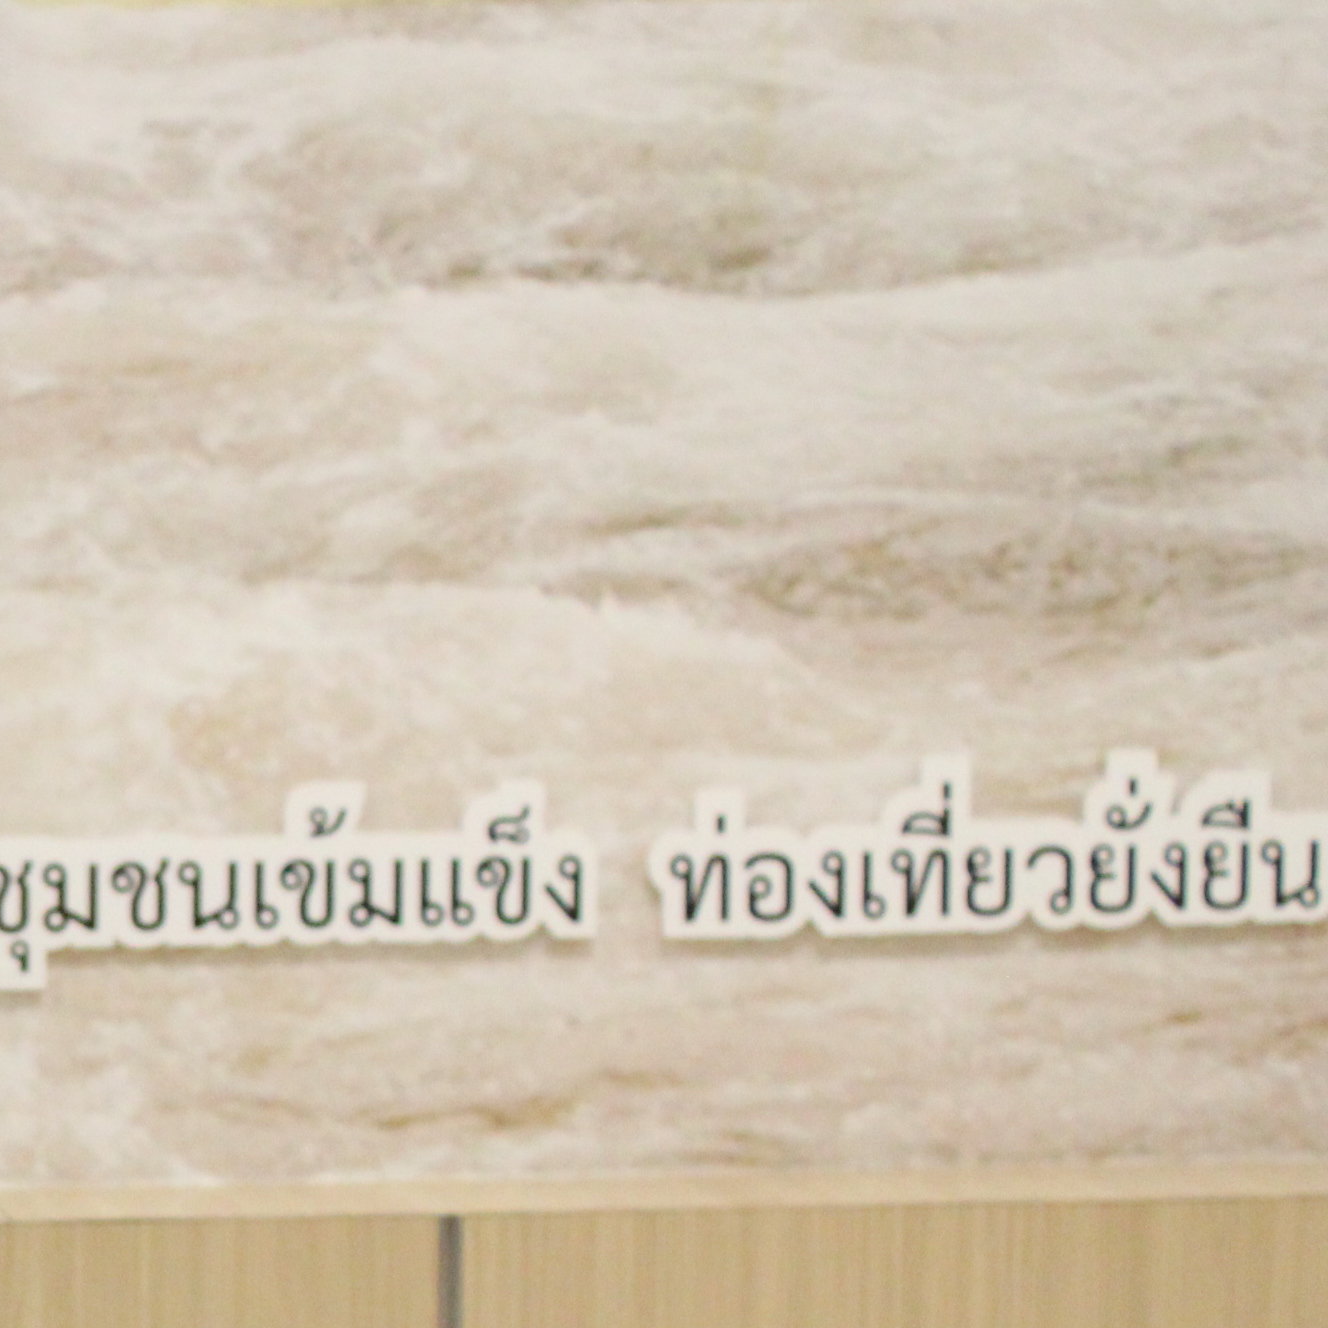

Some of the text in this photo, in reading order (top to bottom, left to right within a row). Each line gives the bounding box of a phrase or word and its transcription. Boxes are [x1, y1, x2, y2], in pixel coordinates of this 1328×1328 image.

[670, 776, 1321, 922] ท่องเที่ยวยั่งยืน
